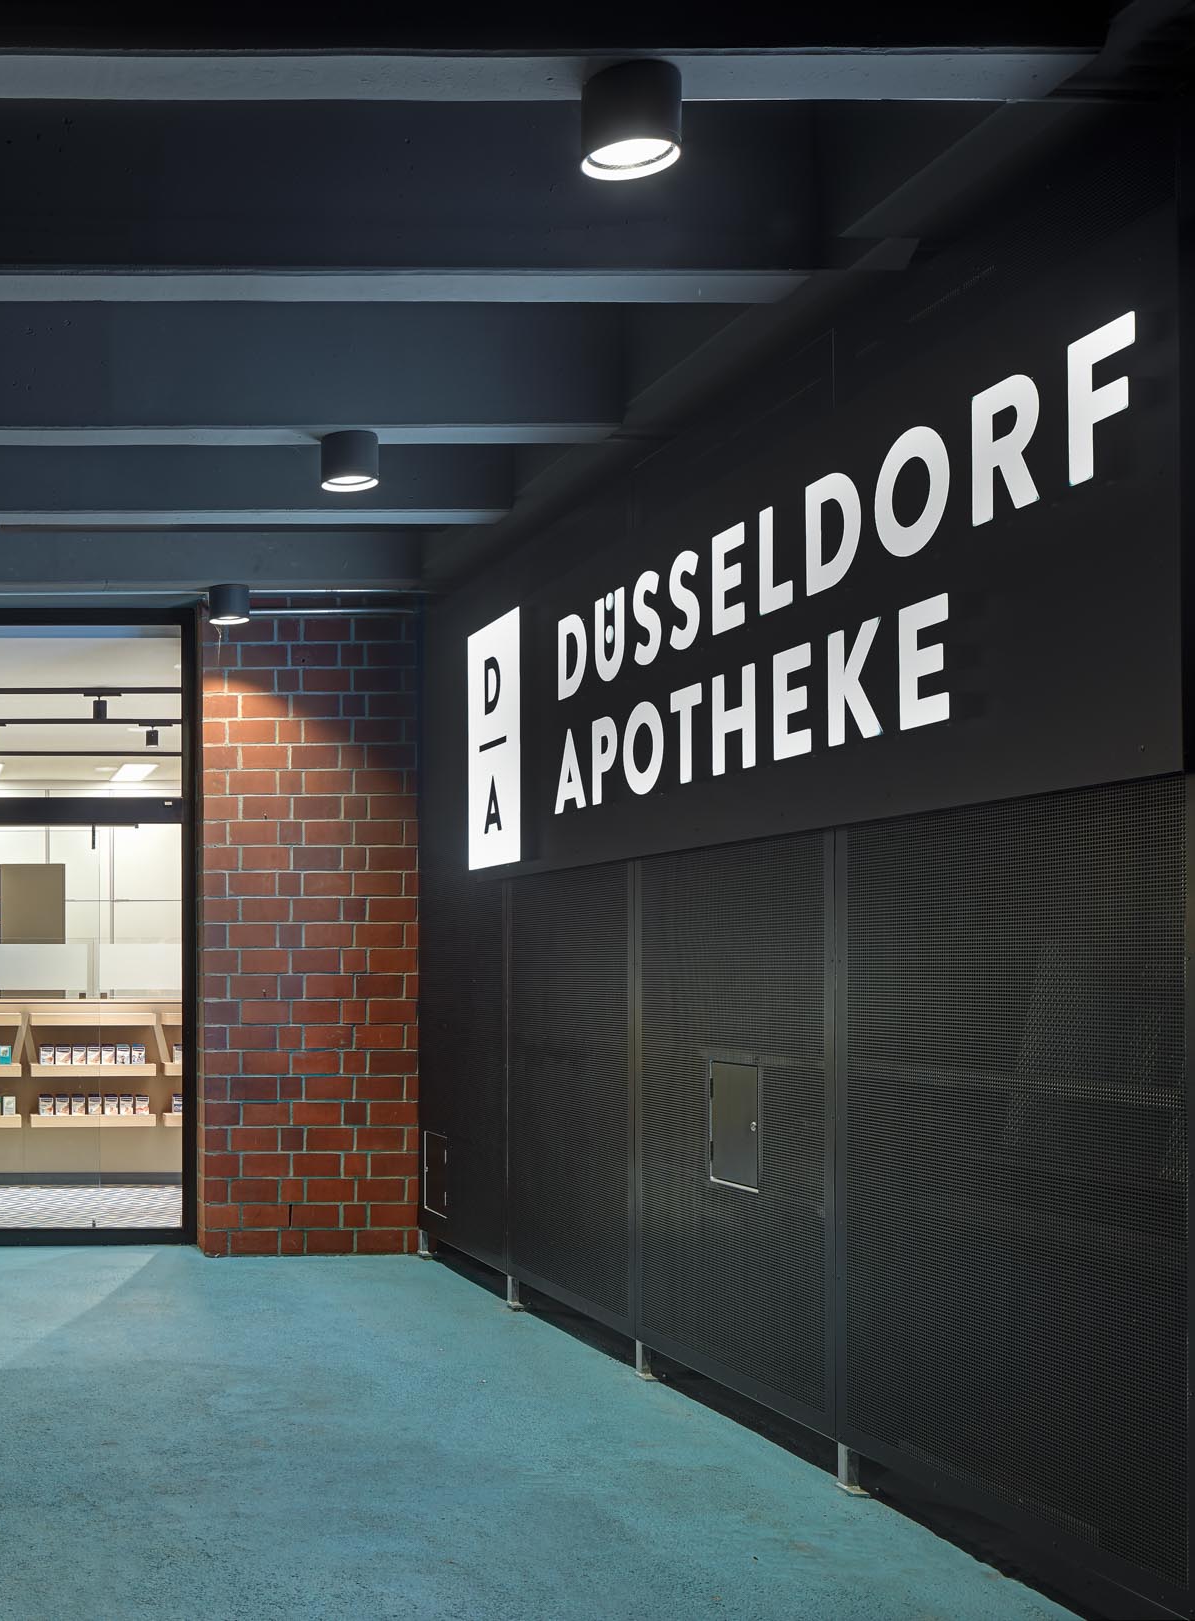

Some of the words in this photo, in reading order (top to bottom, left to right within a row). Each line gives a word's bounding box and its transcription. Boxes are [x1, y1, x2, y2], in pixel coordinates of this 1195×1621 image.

[557, 310, 1135, 700] DÜSSELDORF
[484, 656, 501, 715] D
[554, 592, 950, 814] APOTHEKE
[483, 774, 503, 834] A
